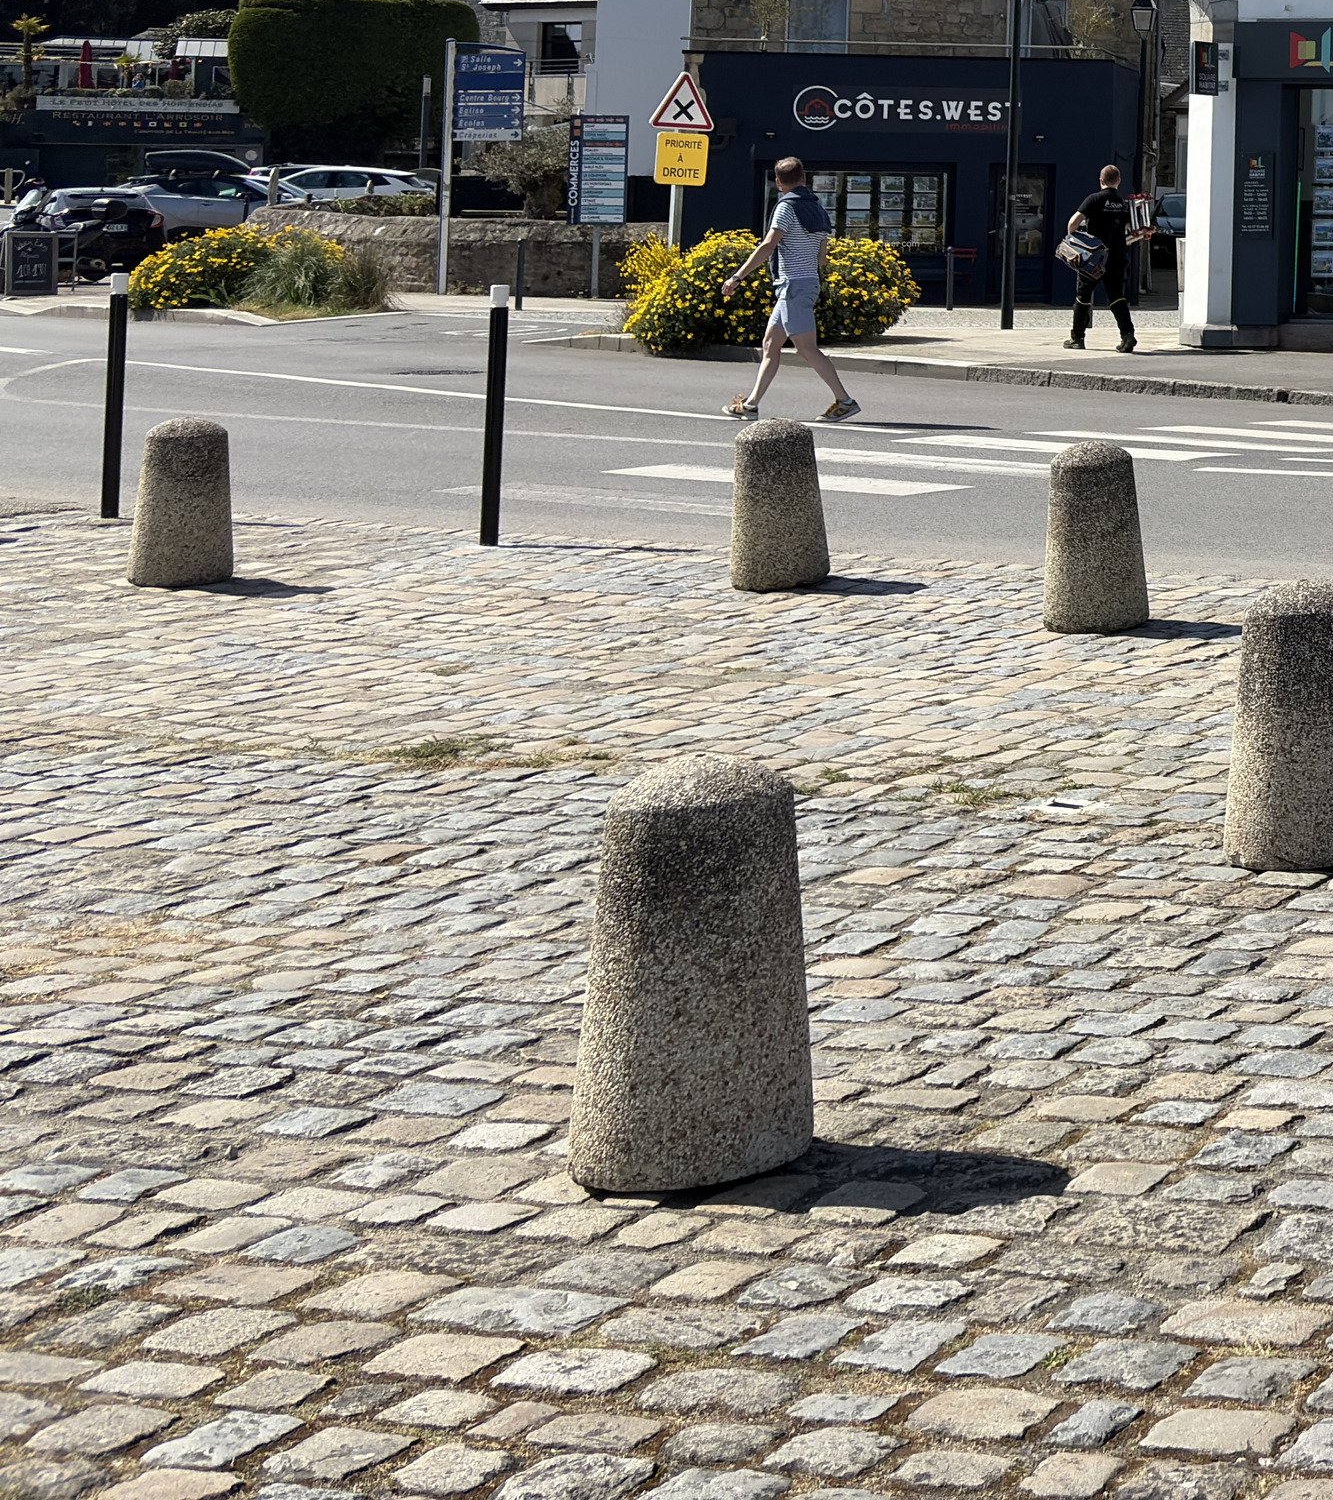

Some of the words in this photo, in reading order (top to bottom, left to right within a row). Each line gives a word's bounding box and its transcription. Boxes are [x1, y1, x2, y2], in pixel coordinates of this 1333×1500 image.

[665, 139, 702, 149] PRIORITÉ
[677, 153, 683, 163] À
[568, 140, 580, 206] COMMERCES
[662, 167, 699, 179] DROITE
